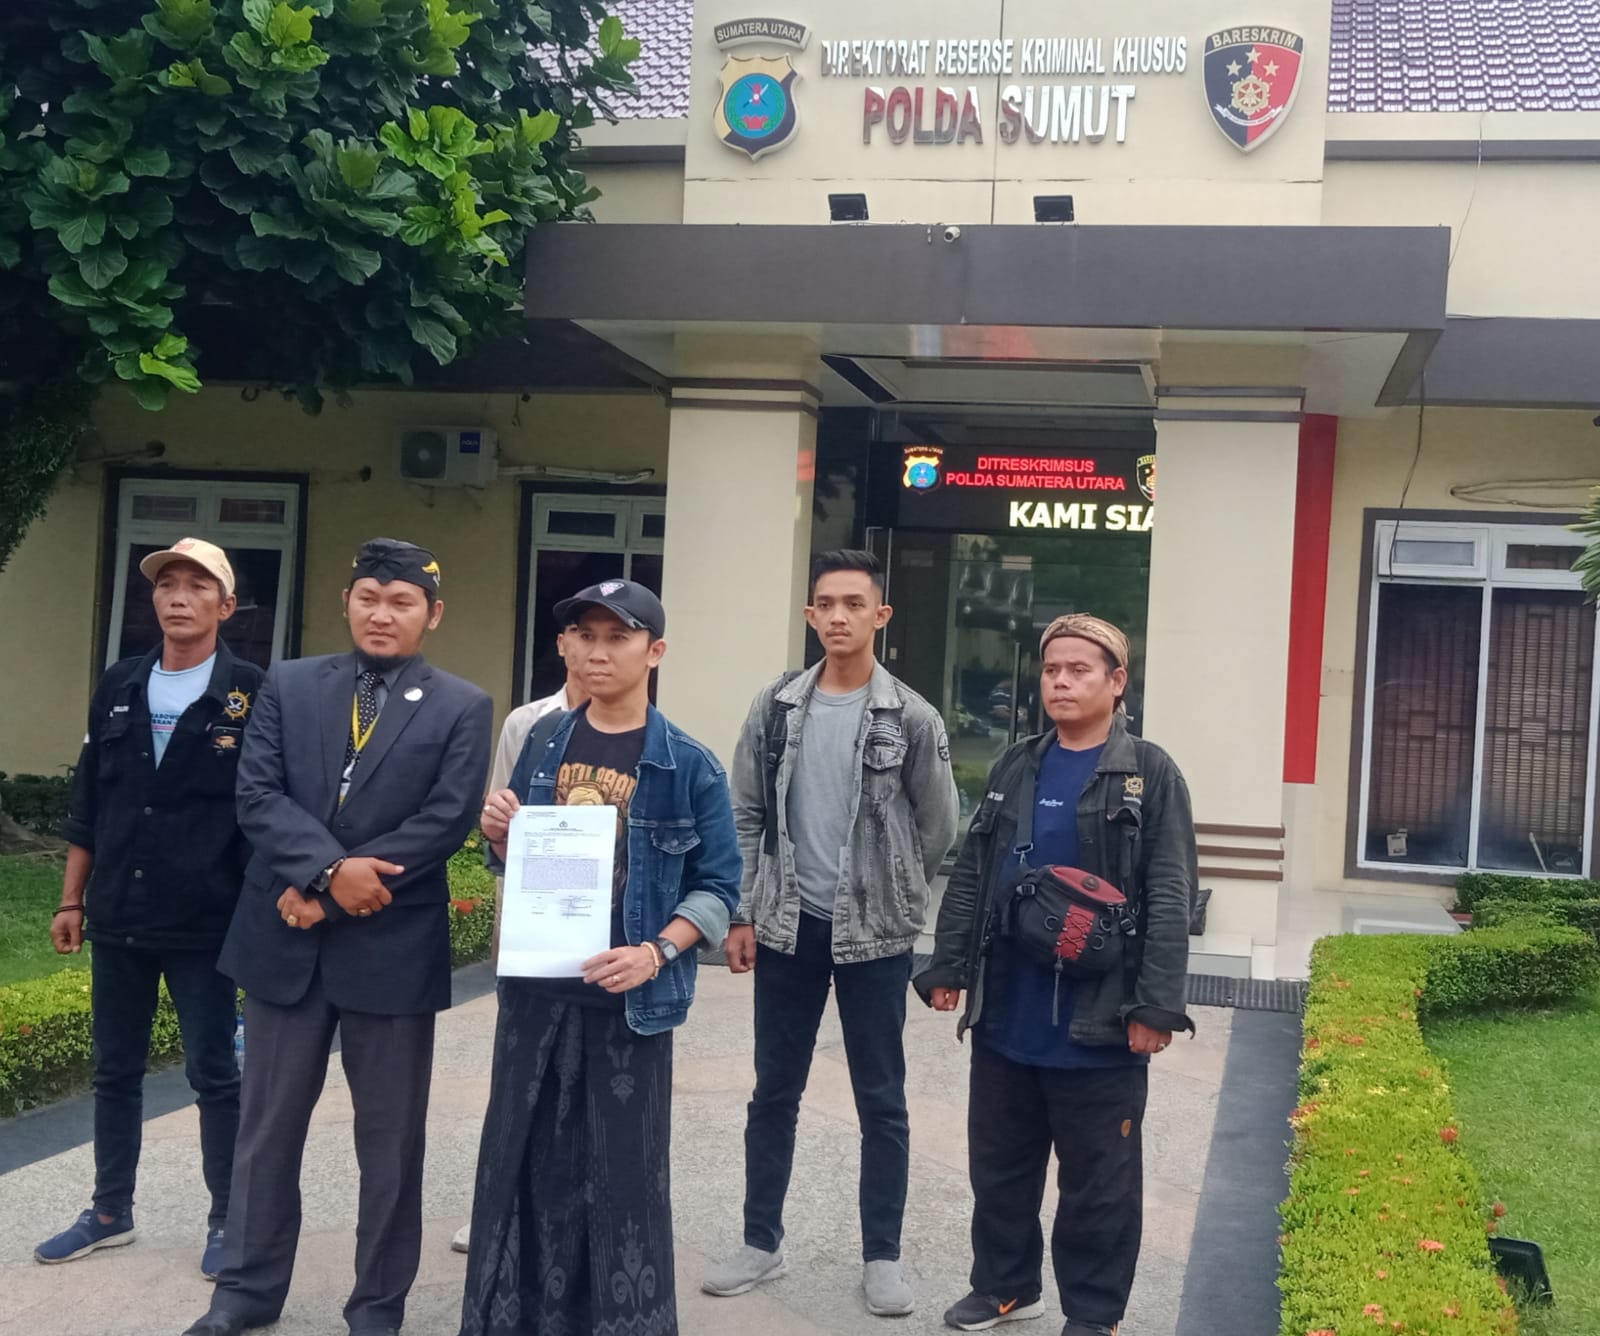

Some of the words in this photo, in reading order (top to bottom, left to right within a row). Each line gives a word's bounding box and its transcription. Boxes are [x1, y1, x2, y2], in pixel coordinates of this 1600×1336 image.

[716, 22, 769, 41] SUMATERA
[770, 24, 801, 41] UTARA
[1211, 28, 1298, 49] BARESKRIM
[820, 39, 931, 77] DIREKTORAT
[935, 38, 1014, 76] RESERSE
[1020, 37, 1106, 75] KRIMINAL
[1112, 36, 1188, 74] KHUSUS
[862, 85, 985, 145] POLDA
[1000, 84, 1137, 145] SUMUT
[977, 456, 1095, 473] DITRESKRIMSUS
[946, 472, 994, 487] POLDA
[996, 473, 1075, 490] SUMATERA
[1076, 476, 1126, 491] UTARA
[1009, 501, 1097, 530] KAMI
